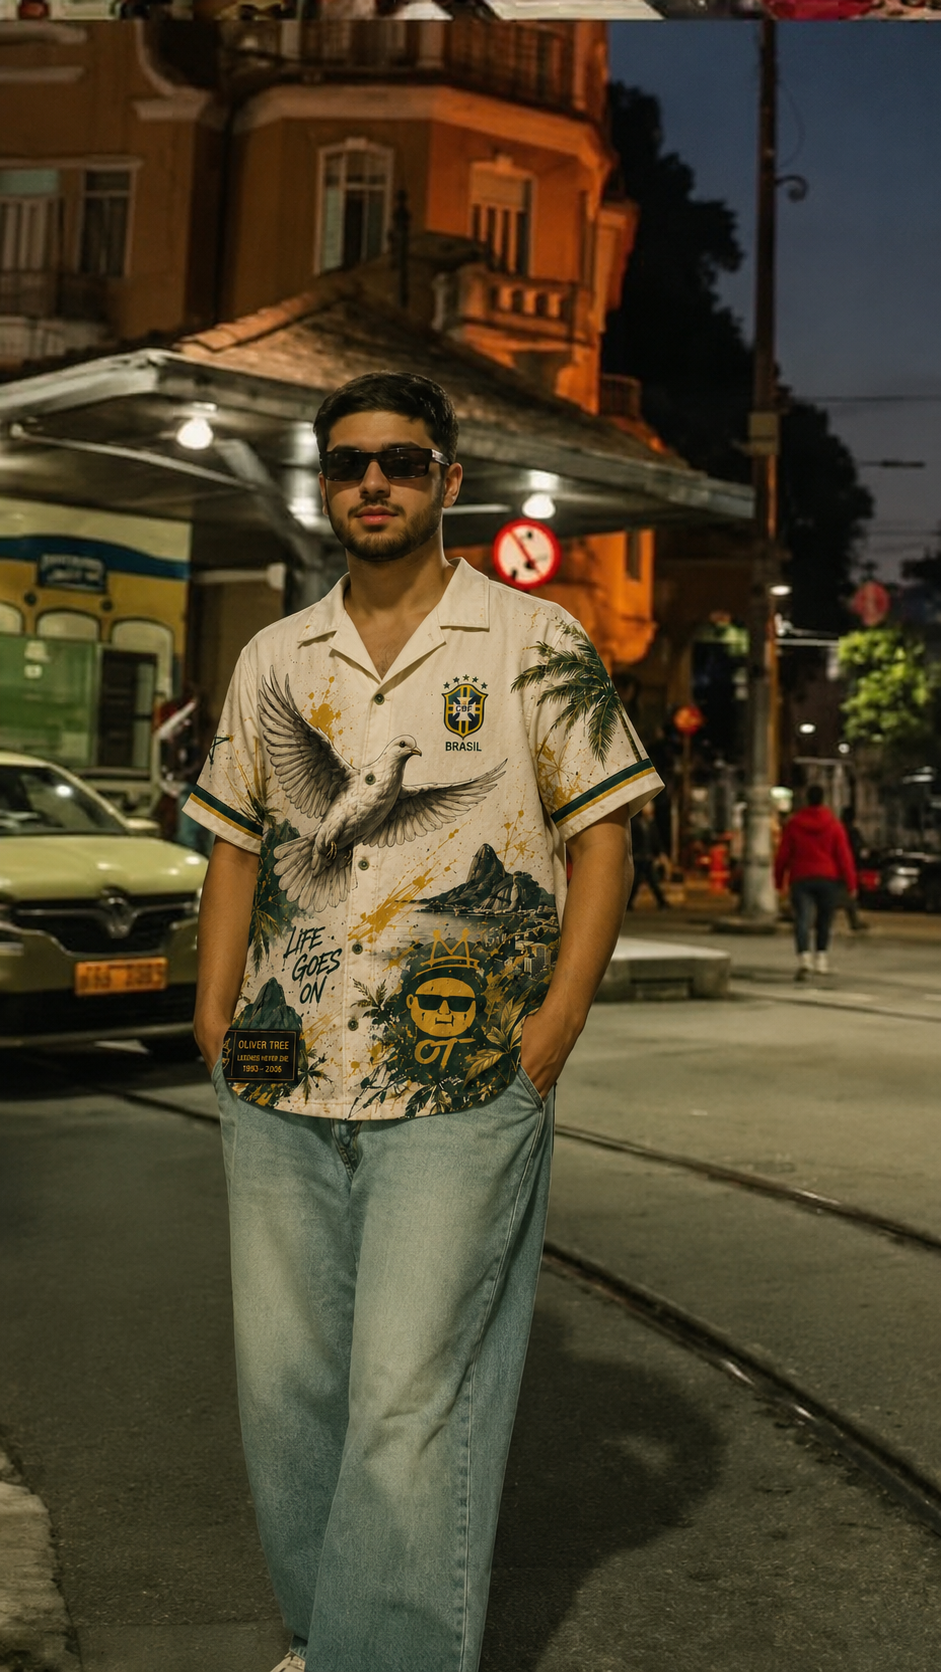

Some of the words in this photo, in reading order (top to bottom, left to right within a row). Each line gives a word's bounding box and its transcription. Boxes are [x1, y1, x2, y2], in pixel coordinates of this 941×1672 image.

[445, 741, 482, 751] BRASIL
[283, 926, 326, 959] LIFE
[292, 948, 342, 988] GOES
[300, 975, 328, 1005] ON
[238, 1040, 267, 1050] OLIVER
[269, 1040, 290, 1050] TREE
